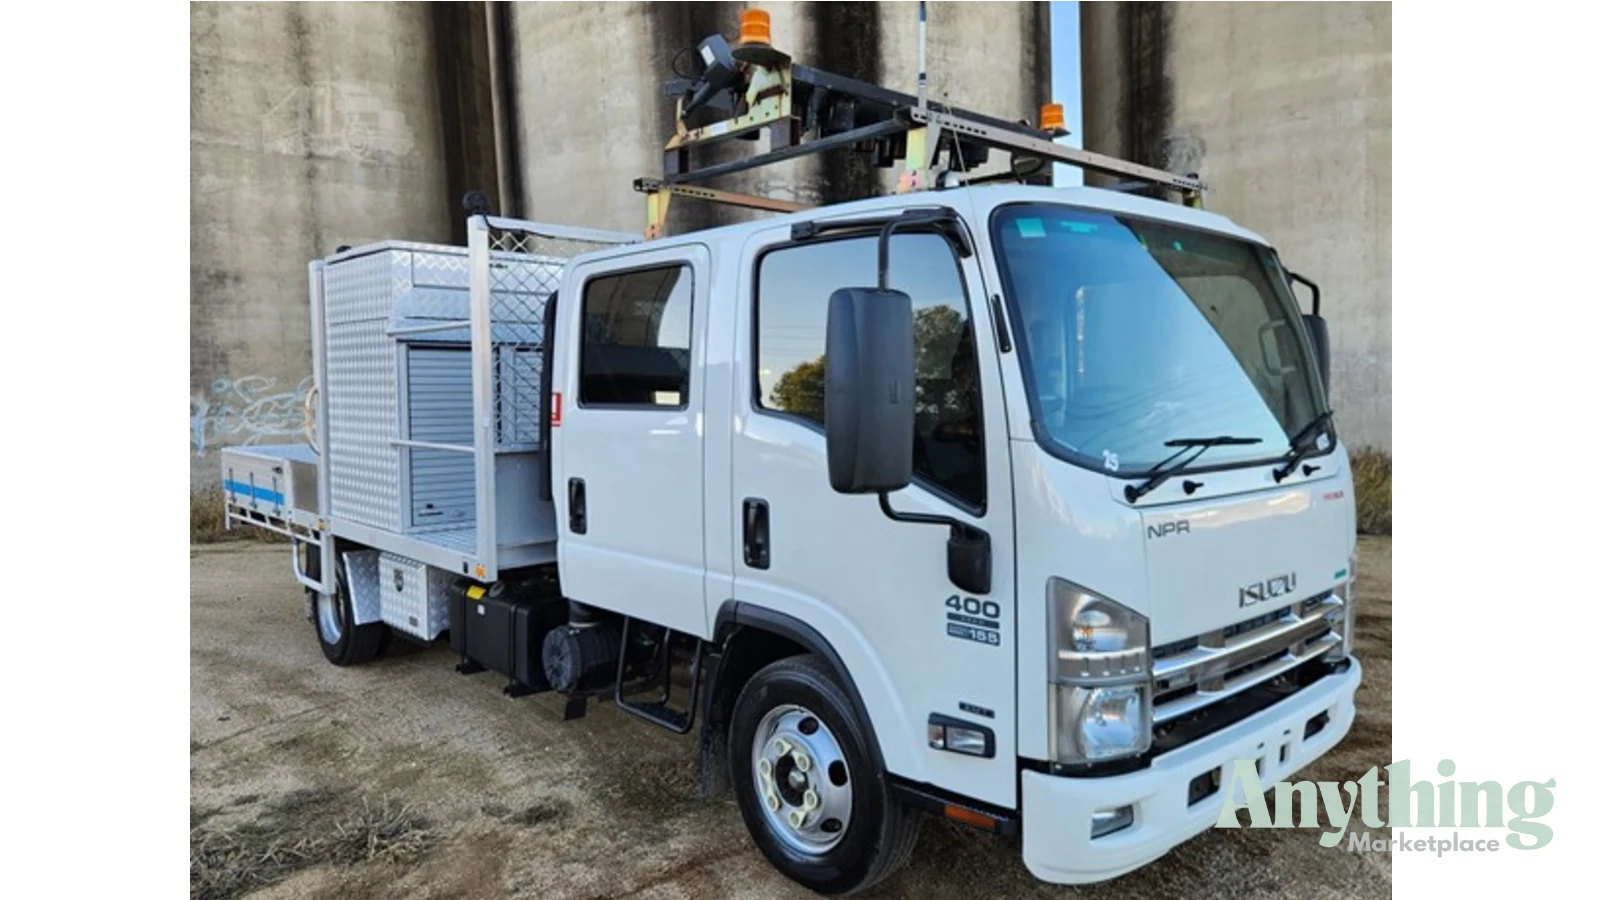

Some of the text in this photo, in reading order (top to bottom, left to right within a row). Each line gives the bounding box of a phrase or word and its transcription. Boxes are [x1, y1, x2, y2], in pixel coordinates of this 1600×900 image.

[1147, 519, 1190, 540] NPR
[1238, 571, 1296, 608] ISUZU
[945, 594, 1000, 618] 400
[968, 629, 998, 644] 155
